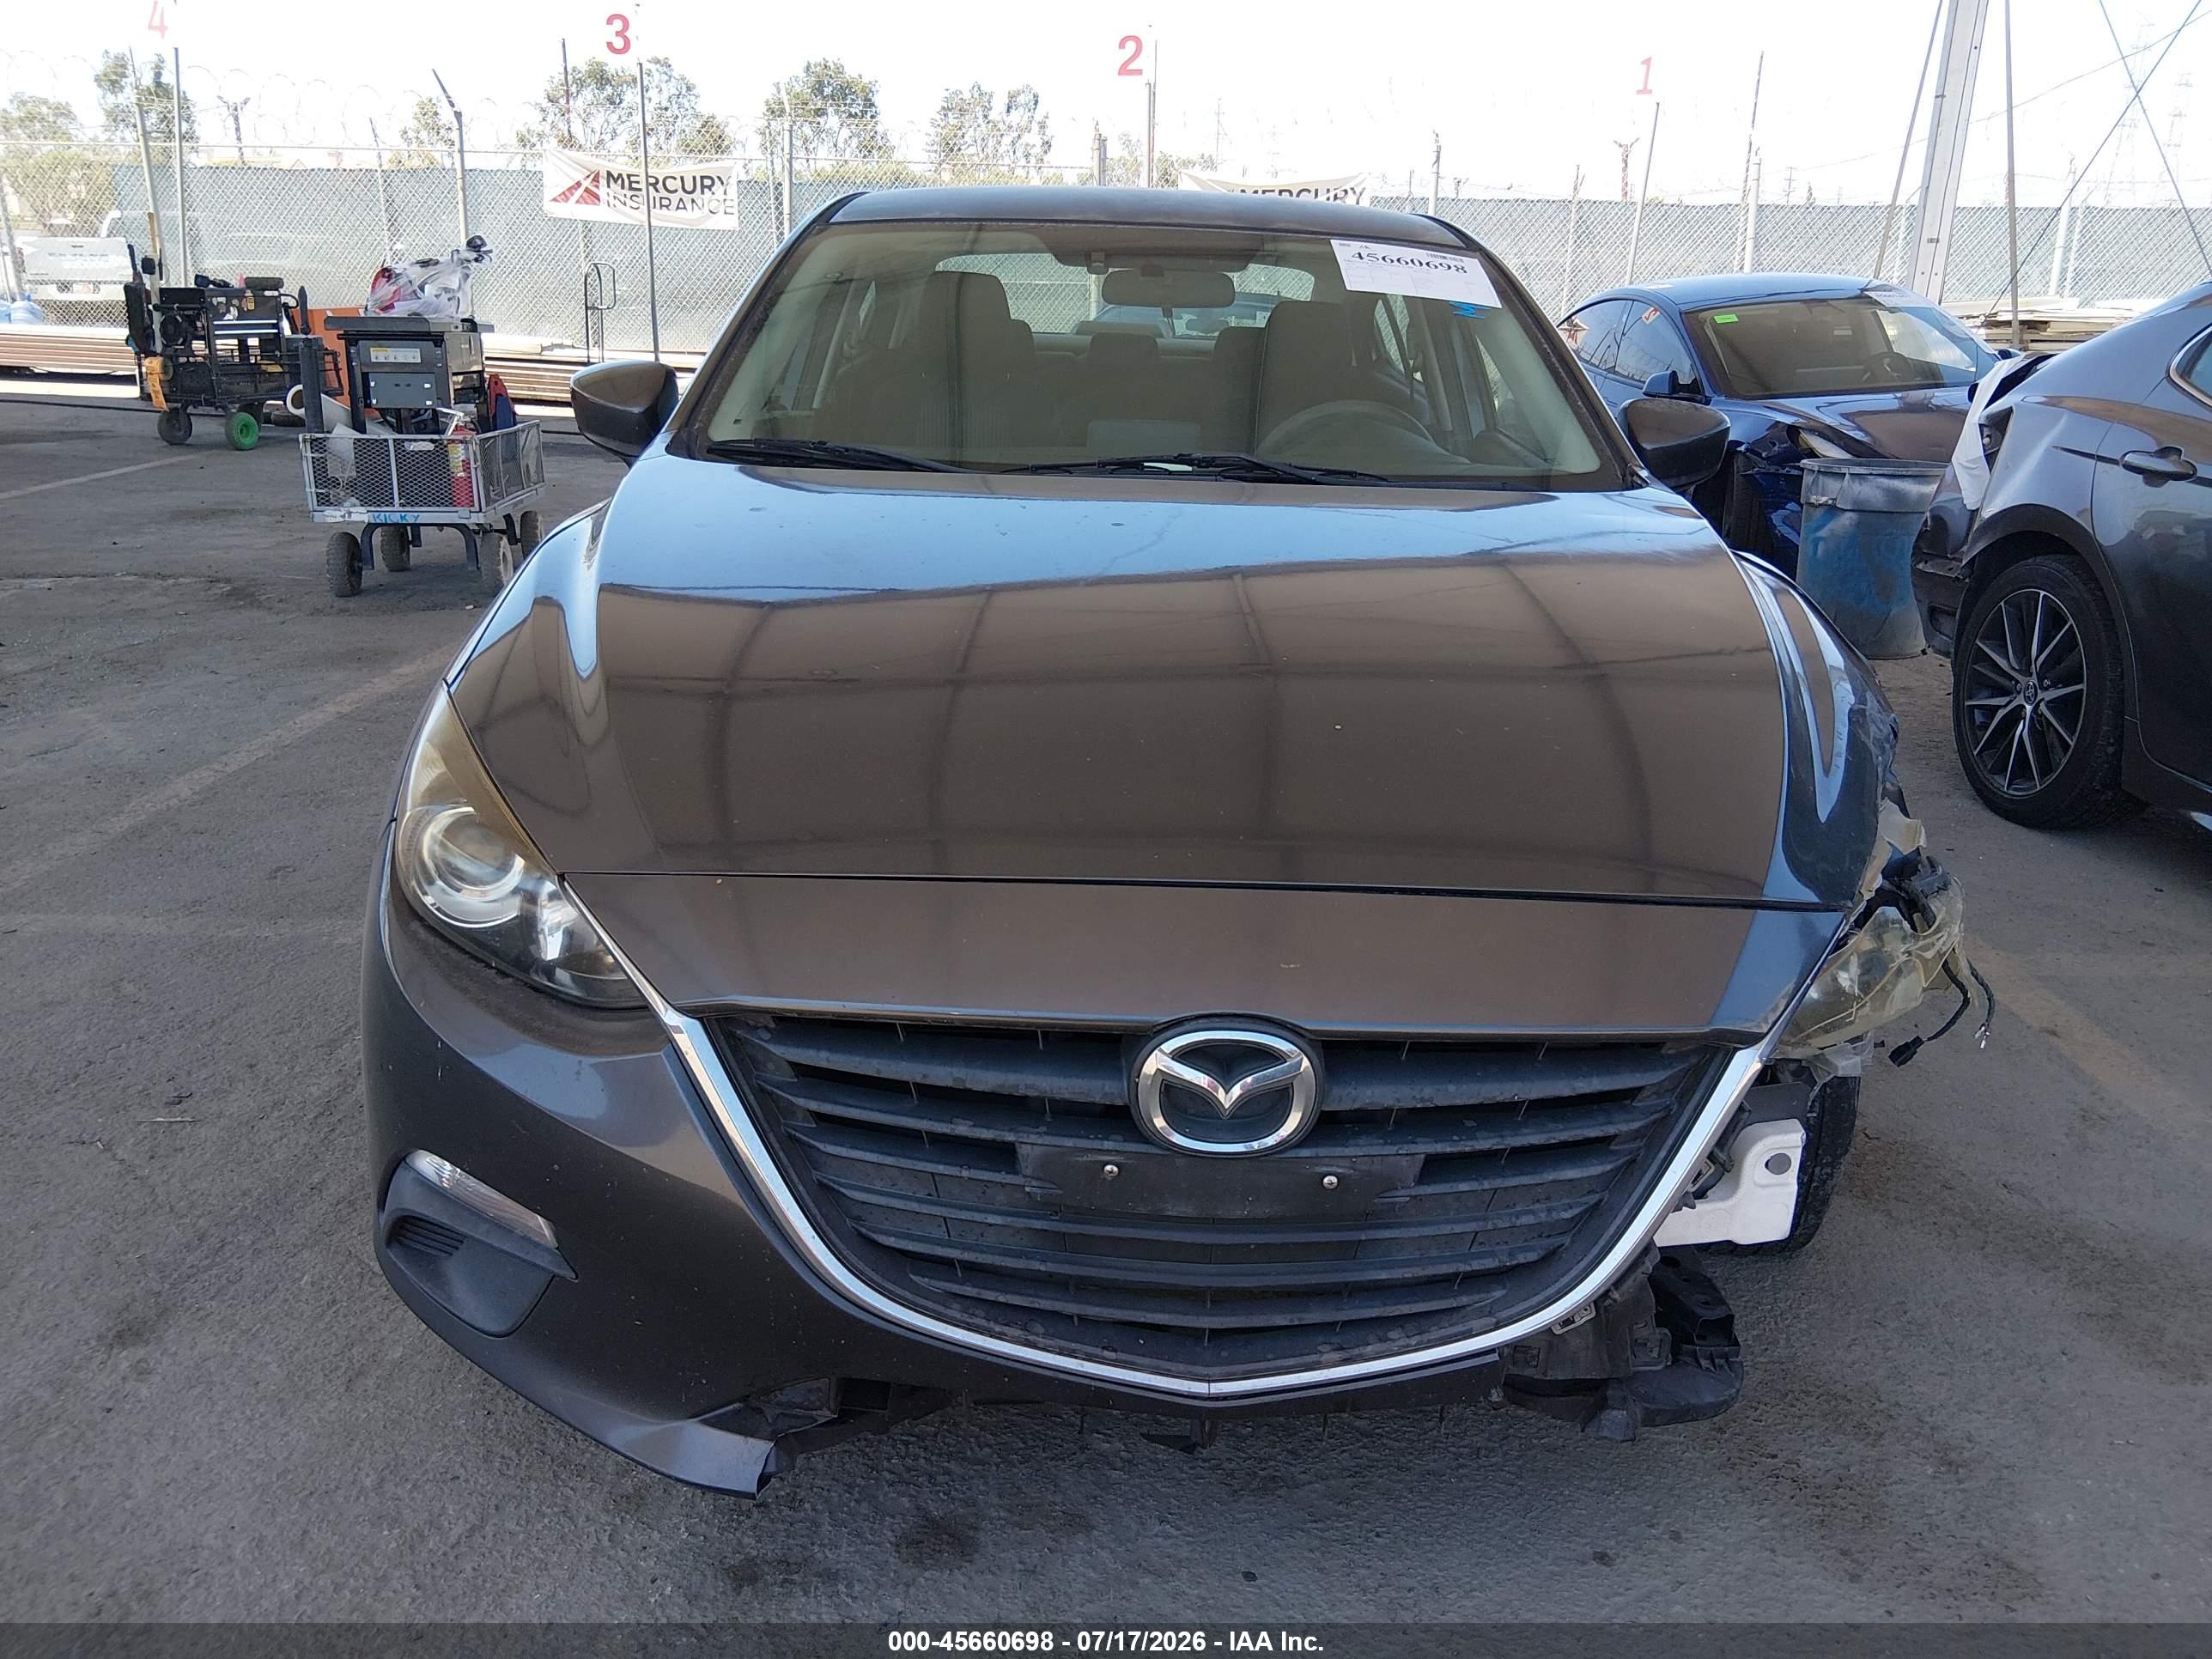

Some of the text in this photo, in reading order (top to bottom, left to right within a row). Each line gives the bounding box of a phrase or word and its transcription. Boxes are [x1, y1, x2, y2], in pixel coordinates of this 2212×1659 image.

[148, 0, 169, 40] 4
[606, 13, 631, 55] 3
[1117, 35, 1143, 76] 2
[1636, 56, 1653, 95] 1
[606, 171, 731, 195] MERCURY
[1240, 186, 1366, 206] CURY
[606, 193, 734, 215] INSURANCE
[1352, 252, 1468, 274] 45660698
